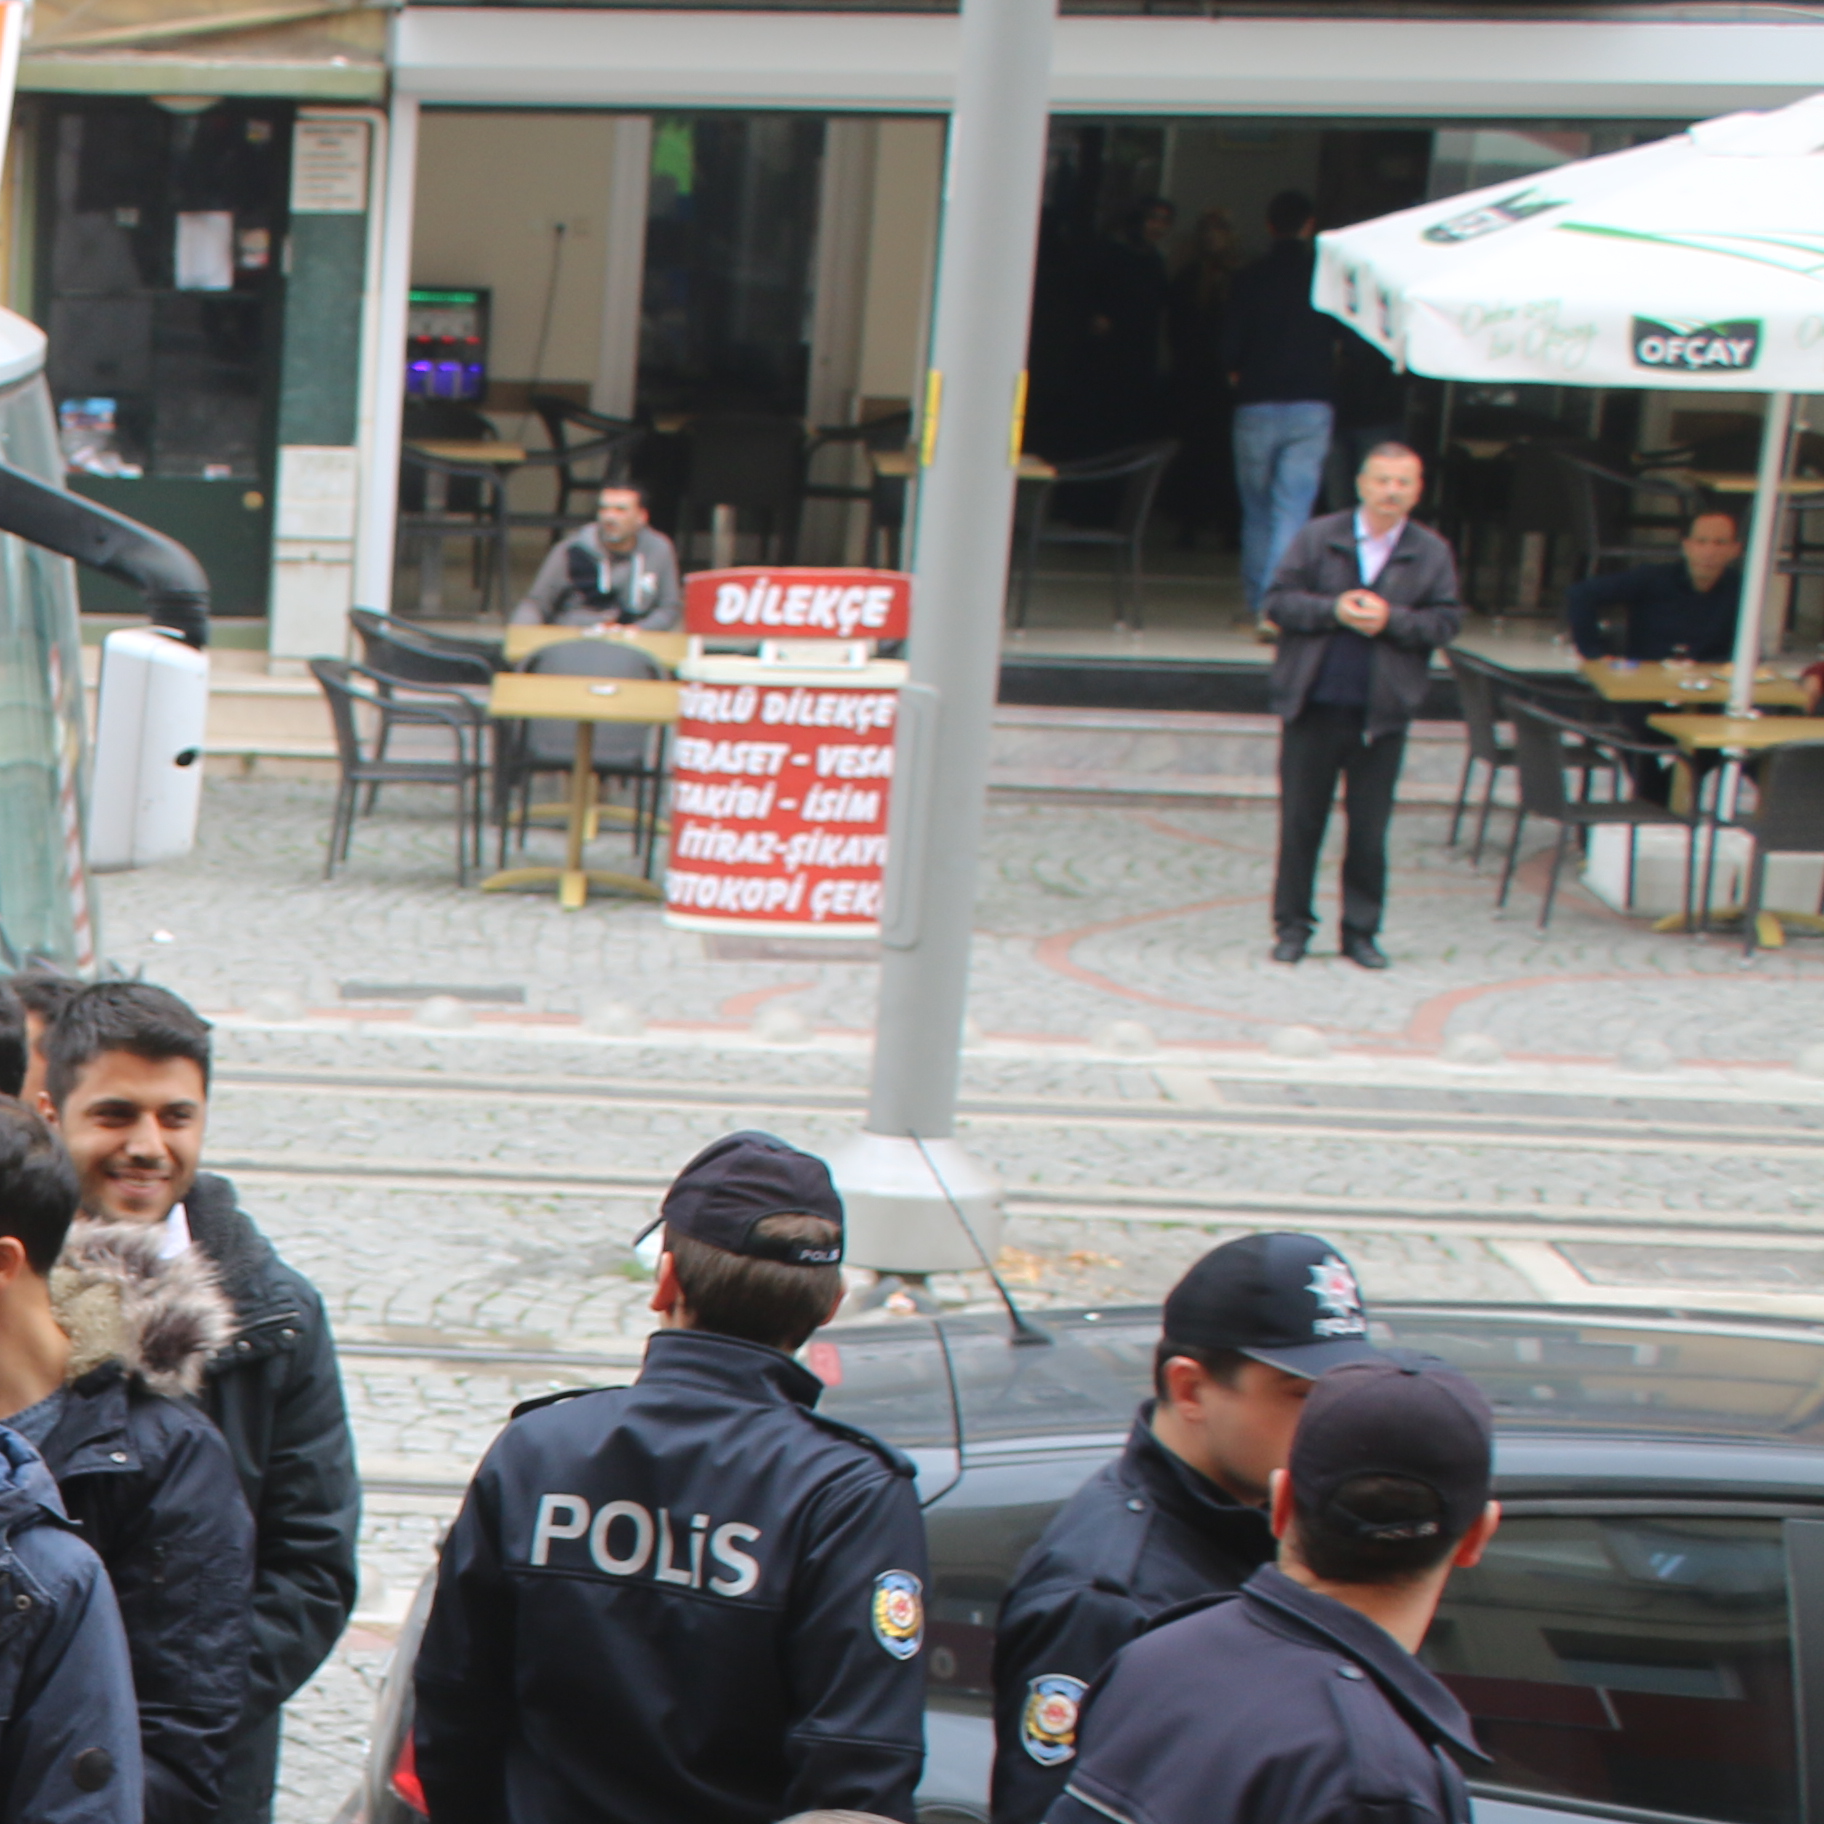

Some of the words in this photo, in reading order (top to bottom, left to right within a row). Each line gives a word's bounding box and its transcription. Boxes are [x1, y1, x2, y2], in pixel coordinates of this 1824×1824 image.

[1637, 336, 1754, 369] OFÇAY
[714, 578, 894, 635] DİLEKÇE
[678, 683, 758, 724] ÜRLÜ
[761, 688, 896, 735] DİLEKÇE
[674, 736, 789, 777] ERASET
[800, 782, 880, 823] İSİM
[809, 880, 883, 921] ÇEK
[530, 1493, 762, 1598] POLİS
